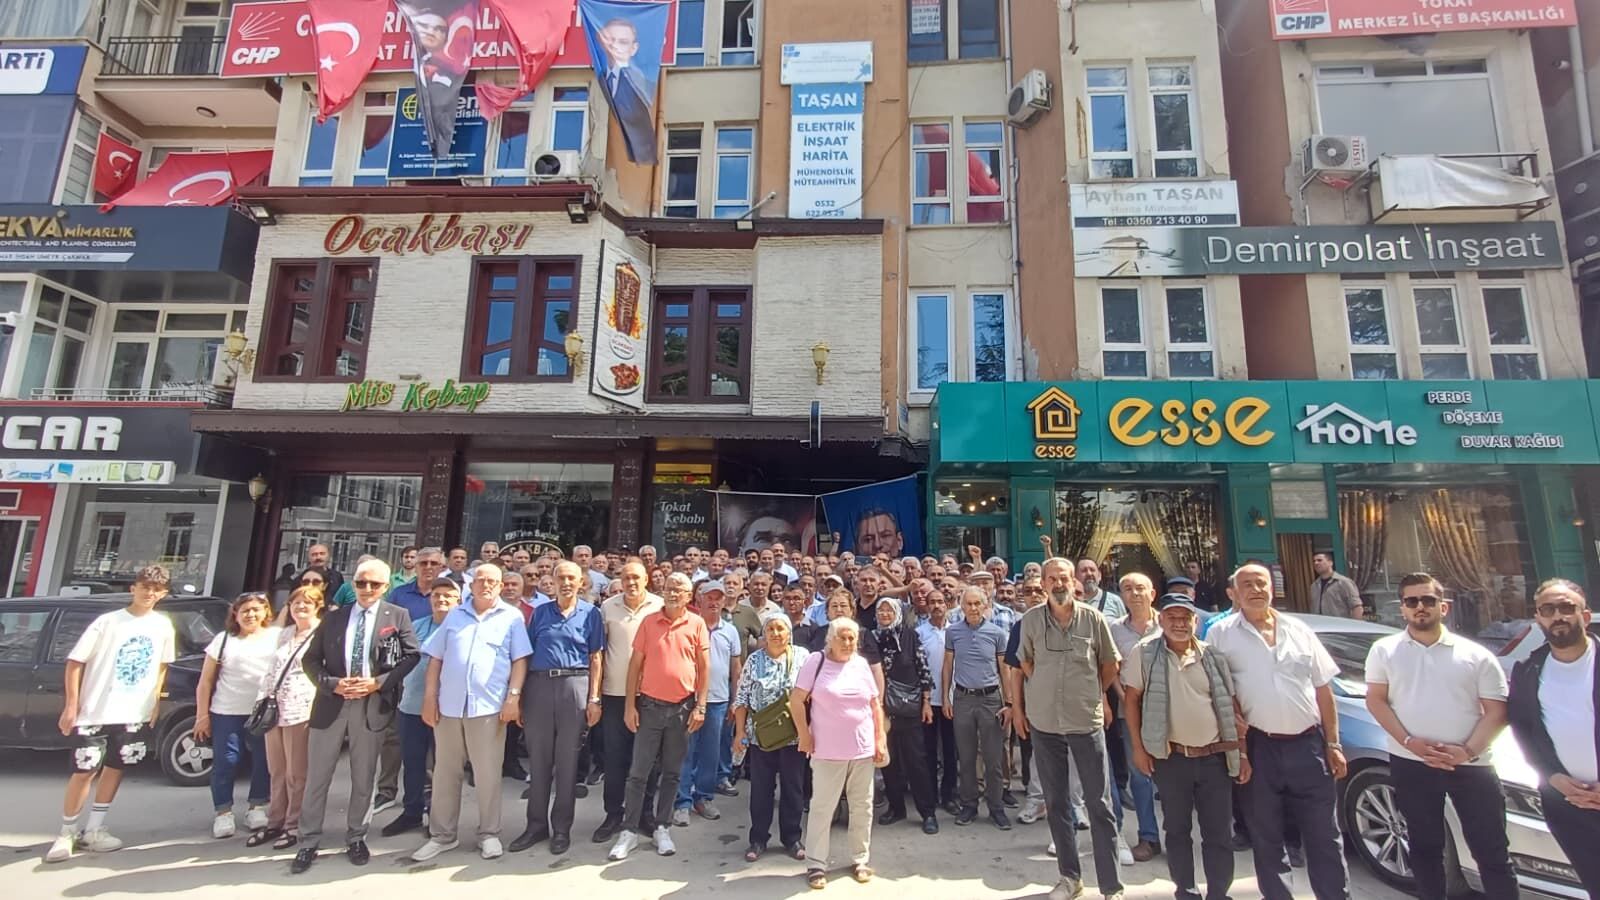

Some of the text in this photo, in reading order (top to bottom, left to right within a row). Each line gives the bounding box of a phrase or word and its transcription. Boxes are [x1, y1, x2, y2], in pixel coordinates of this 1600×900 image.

[1281, 15, 1325, 30] CHP
[1338, 6, 1565, 30] MERKEZ İLÇE BAŞKANLIĞI
[0, 52, 46, 70] RTi
[231, 46, 281, 65] CHP
[798, 92, 857, 109] TAŞAN
[797, 120, 856, 132] ELEKTRİK
[804, 136, 848, 148] İNŞAAT
[803, 150, 848, 161] HARİTA
[797, 167, 854, 176] MÜHENDİSLİK
[794, 178, 857, 186] MÜTEAHHİTLİK
[1088, 187, 1224, 205] Ayhan TAŞAN
[1126, 217, 1152, 225] 0356
[1156, 216, 1175, 225] 213
[1178, 215, 1191, 224] 40
[1194, 215, 1208, 224] 90
[64, 224, 135, 238] MİMARLIK
[324, 213, 534, 254] Ocakbaşı
[1206, 226, 1546, 268] Demirpolat İnşaat
[339, 379, 491, 412] Mis Kebap
[1427, 391, 1473, 404] PERDE
[1108, 397, 1276, 446] esse
[1443, 409, 1504, 426] DÖŞEME
[0, 416, 123, 451] CAR
[1461, 432, 1564, 448] DUVAR KAĞIDI
[1035, 444, 1077, 459] esse
[660, 501, 691, 512] Tokat
[664, 513, 705, 525] Kebabı
